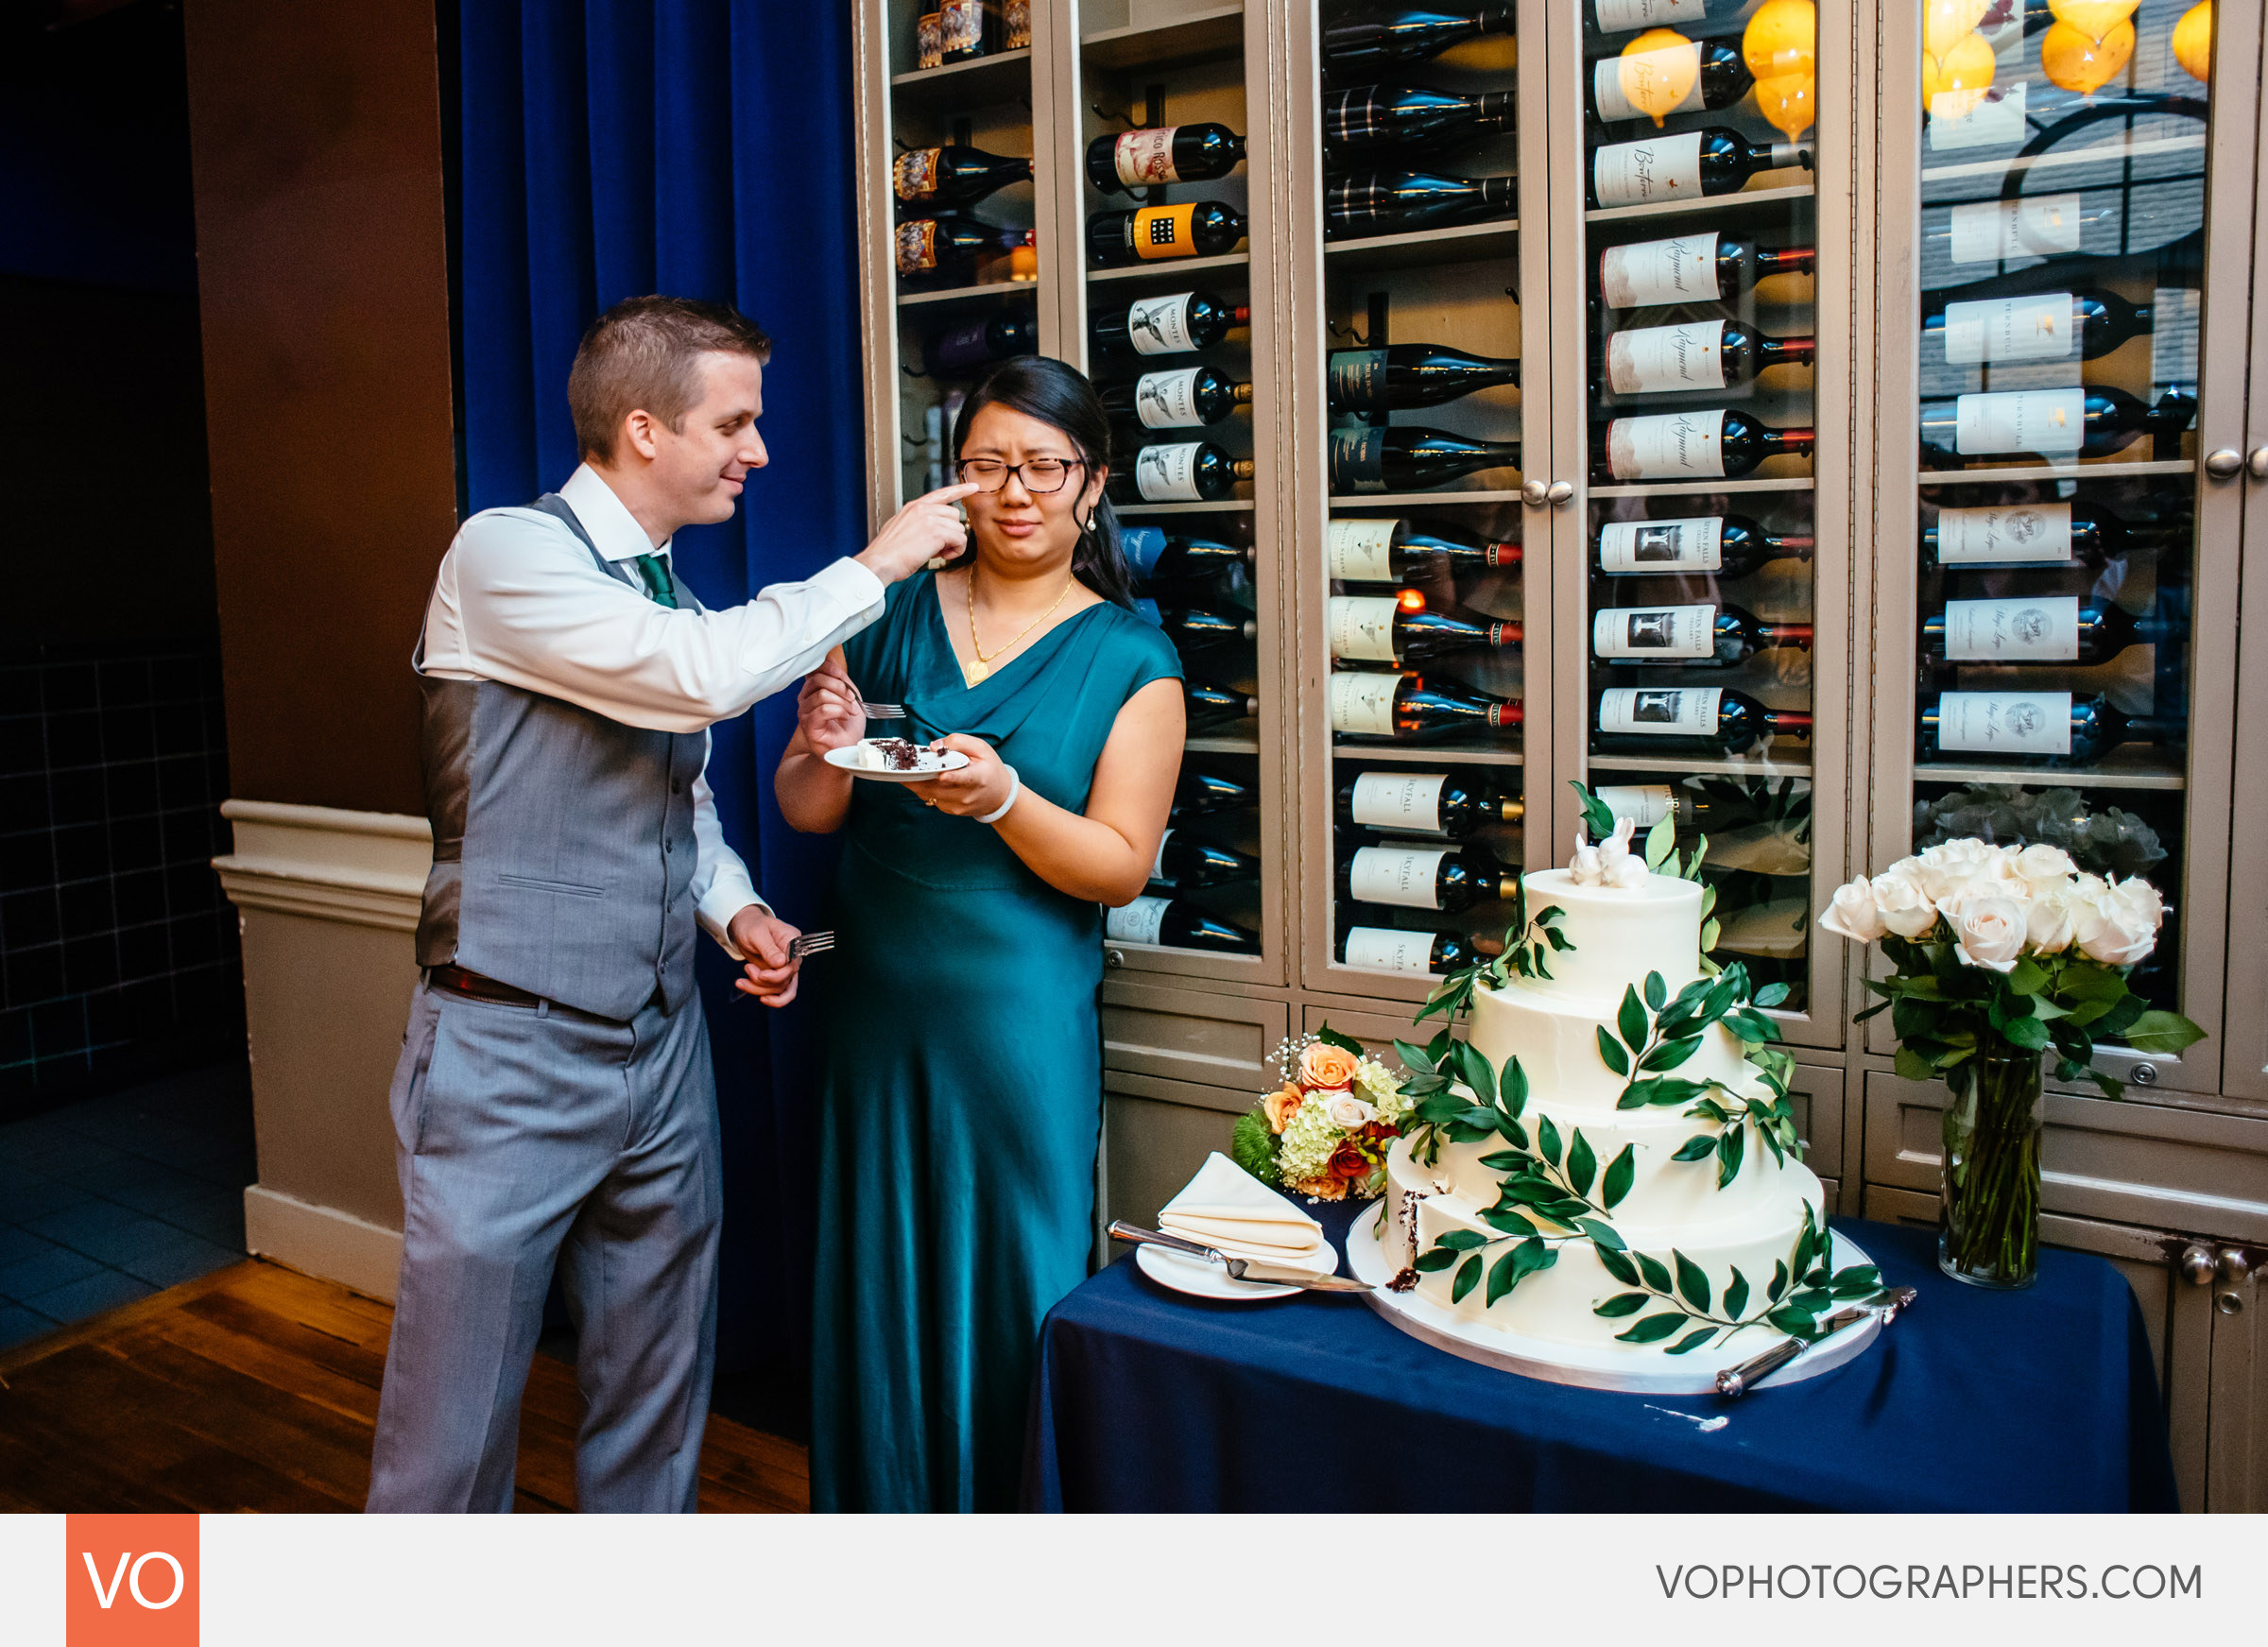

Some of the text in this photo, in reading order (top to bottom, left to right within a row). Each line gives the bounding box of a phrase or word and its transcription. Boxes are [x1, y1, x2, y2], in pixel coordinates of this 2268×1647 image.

[1664, 240, 1692, 292] Raymond
[1170, 308, 1180, 344] MONTES
[1670, 327, 1695, 381] Raymond
[1177, 380, 1187, 417] MONTES
[1670, 416, 1696, 469] Raymond
[1177, 447, 1187, 482] MONTES
[1701, 542, 1710, 564] FALLS
[1693, 629, 1702, 652] FALLS
[1700, 706, 1709, 728] FALLS
[1403, 779, 1417, 814] SKYFALL
[1401, 856, 1414, 892] SKYFALL
[1397, 944, 1406, 971] SKYFA
